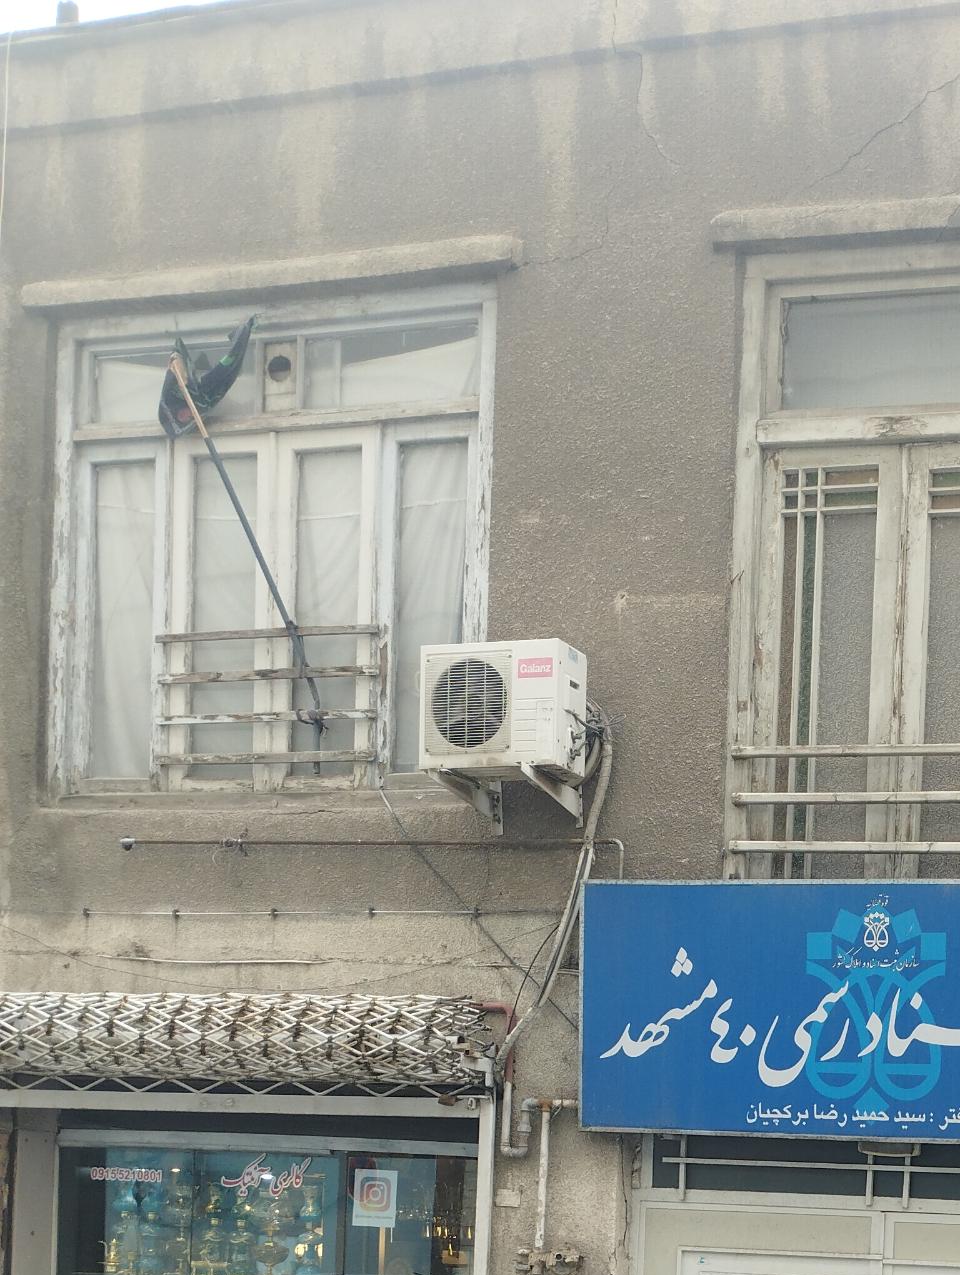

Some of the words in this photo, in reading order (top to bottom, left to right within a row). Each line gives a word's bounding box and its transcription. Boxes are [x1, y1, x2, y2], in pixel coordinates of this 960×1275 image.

[519, 663, 552, 674] Galanz
[879, 948, 899, 972] ثبت
[895, 952, 920, 972] سازمان
[599, 946, 718, 1059] مشهد
[757, 979, 850, 1089] رسمی
[813, 1103, 848, 1128] رضا
[851, 1108, 890, 1129] حمید
[893, 1110, 926, 1131] سید
[90, 1166, 163, 1183] 09155210801
[269, 1156, 312, 1198] گالری
